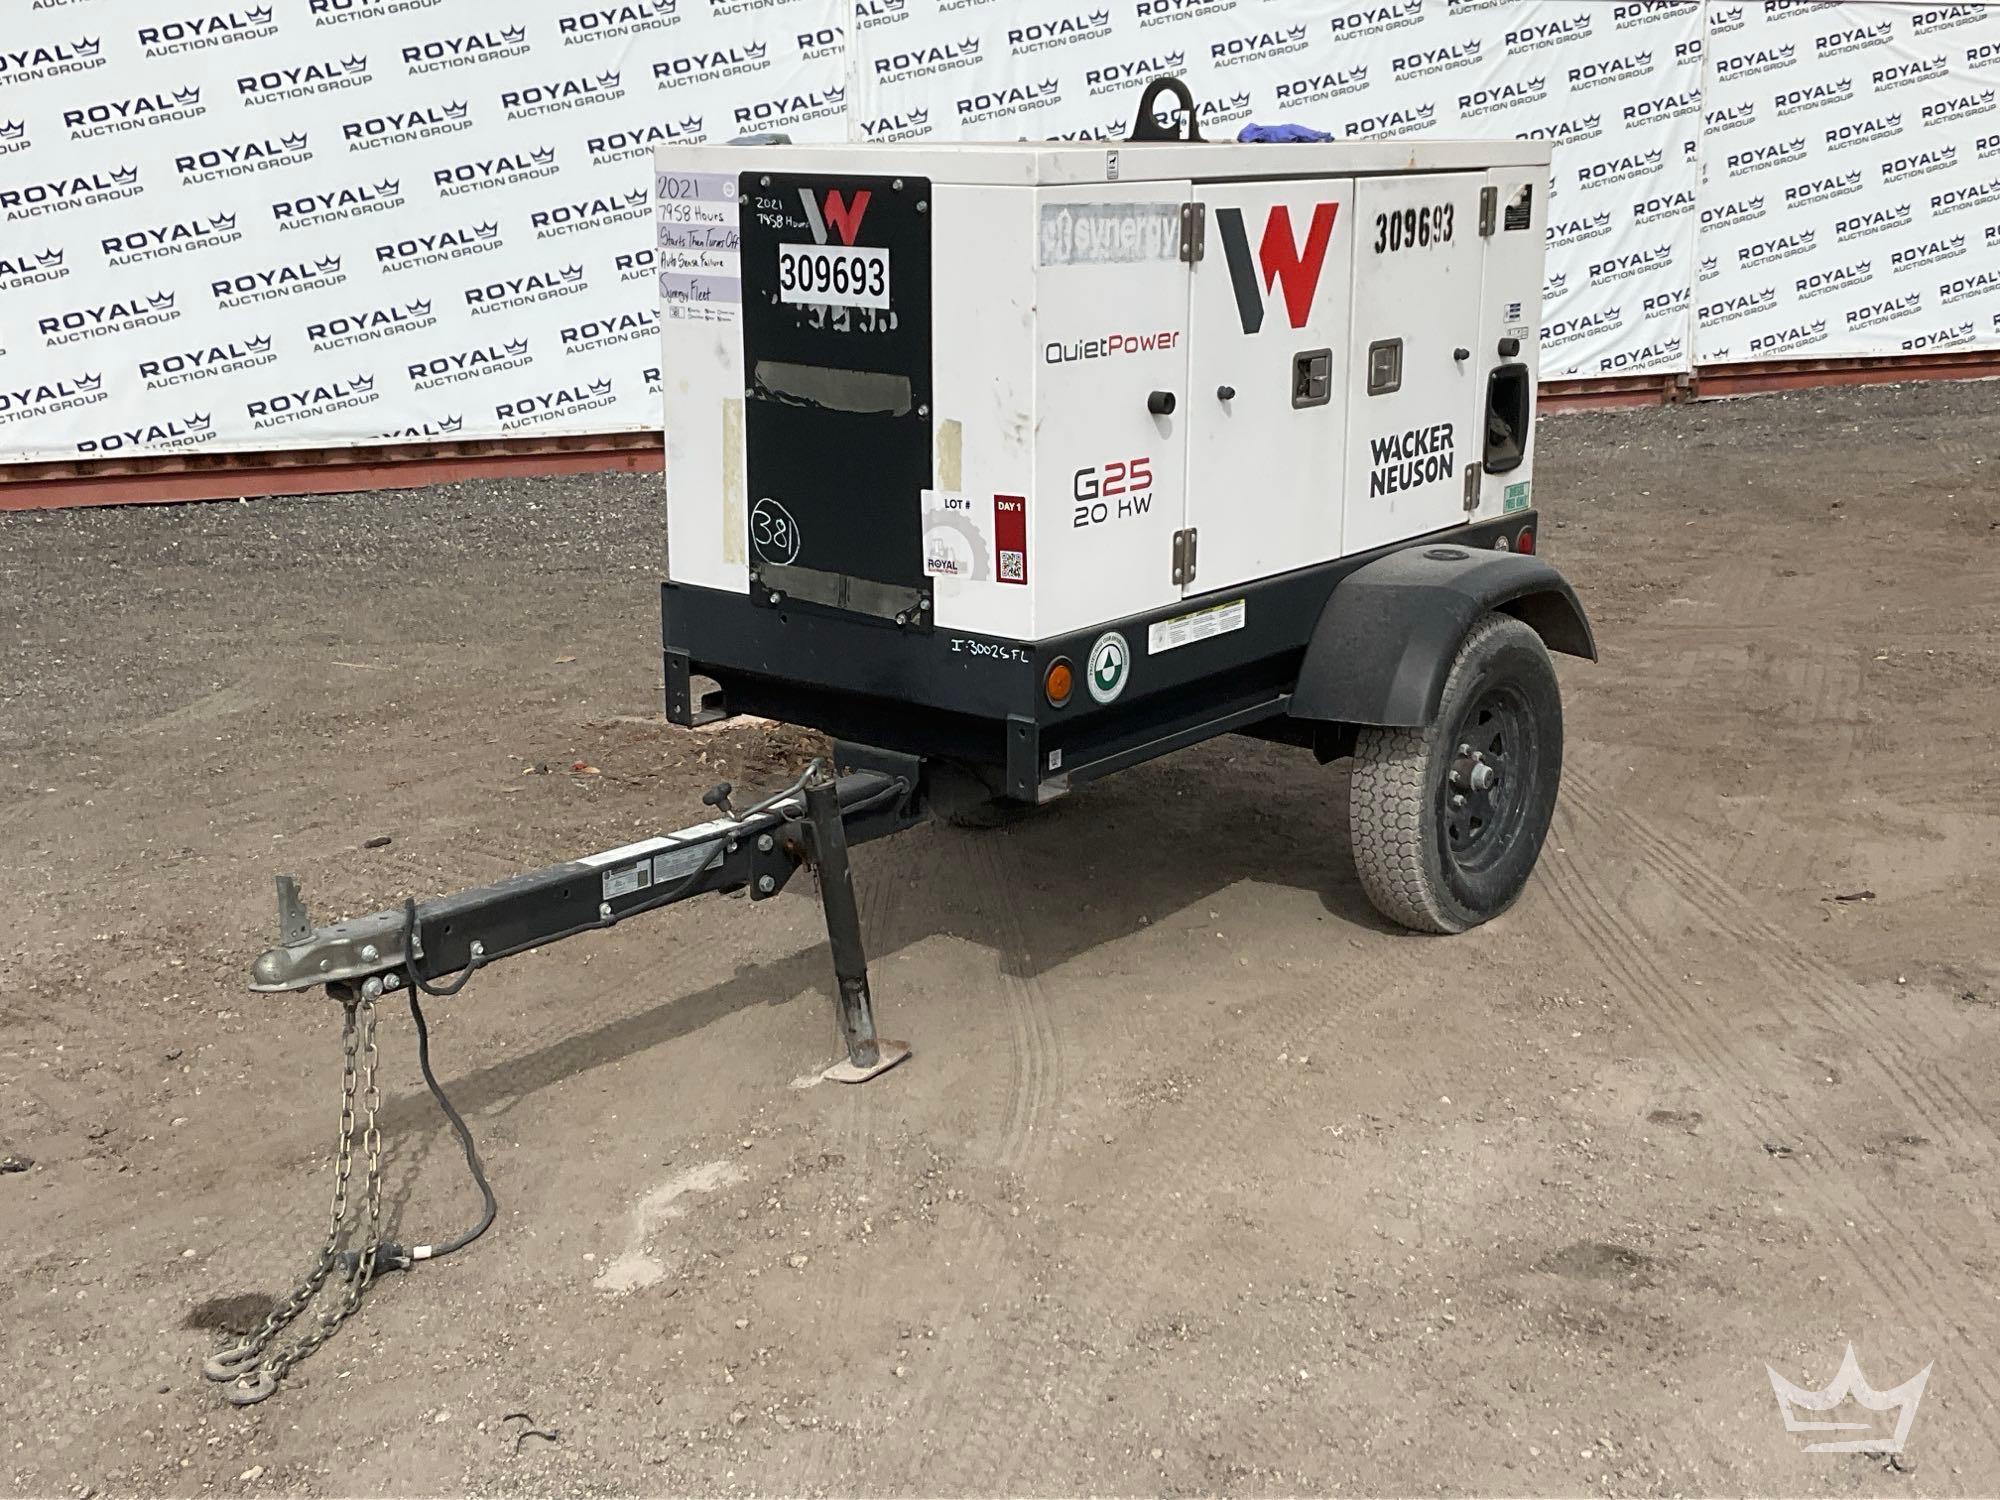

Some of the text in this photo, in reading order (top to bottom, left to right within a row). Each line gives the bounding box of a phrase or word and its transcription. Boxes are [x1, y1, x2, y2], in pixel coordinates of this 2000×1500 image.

[138, 12, 247, 45] ROYAL
[558, 3, 654, 34] ROYAL
[564, 16, 681, 46] AUCTION GROUP
[1007, 16, 1089, 45] ROYAL
[1331, 5, 1404, 32] ROYAL
[1333, 16, 1424, 43] AUCTION GROUP
[1504, 19, 1573, 46] ROYAL
[145, 26, 279, 58] AUCTION GROUP
[401, 32, 502, 63] ROYAL
[1011, 27, 1112, 56] AUCTION GROUP
[1210, 30, 1287, 58] ROYAL
[1214, 41, 1309, 69] AUCTION GROUP
[1506, 29, 1592, 56] AUCTION GROUP
[408, 45, 530, 76] AUCTION GROUP
[652, 48, 744, 78] ROYAL
[874, 44, 959, 74] ROYAL
[878, 55, 983, 85] AUCTION GROUP
[1716, 49, 1779, 73] ROYAL
[1718, 58, 1796, 83] AUCTION GROUP
[237, 62, 342, 94] ROYAL
[657, 60, 771, 90] AUCTION GROUP
[1276, 71, 1349, 99] ROYAL
[244, 74, 373, 107] AUCTION GROUP
[501, 77, 597, 109] ROYAL
[507, 90, 625, 121] AUCTION GROUP
[956, 85, 1038, 115] ROYAL
[1278, 82, 1369, 110] AUCTION GROUP
[1458, 82, 1528, 109] ROYAL
[63, 94, 174, 128] ROYAL
[960, 96, 1062, 126] AUCTION GROUP
[1460, 92, 1547, 120] AUCTION GROUP
[1921, 94, 1980, 118] ROYAL
[1923, 103, 1996, 128] AUCTION GROUP
[70, 106, 206, 141] AUCTION GROUP
[342, 108, 444, 140] ROYAL
[349, 120, 473, 152] AUCTION GROUP
[1825, 118, 1886, 143] ROYAL
[1827, 127, 1903, 152] AUCTION GROUP
[175, 139, 282, 173] ROYAL
[182, 152, 313, 186] AUCTION GROUP
[433, 154, 531, 186] ROYAL
[1578, 154, 1645, 181] ROYAL
[1727, 142, 1789, 168] ROYAL
[1729, 152, 1806, 178] AUCTION GROUP
[439, 165, 560, 198] AUCTION GROUP
[658, 176, 699, 199] 2021
[1580, 164, 1663, 191] AUCTION GROUP
[1784, 175, 1846, 201] ROYAL
[272, 186, 375, 219] ROYAL
[530, 196, 625, 228] ROYAL
[659, 203, 724, 221] 7958 Hours
[755, 196, 783, 210] 2021
[1786, 184, 1862, 210] AUCTION GROUP
[279, 198, 405, 232] AUCTION GROUP
[536, 207, 652, 240] AUCTION GROUP
[756, 213, 784, 228] 7958
[1374, 202, 1454, 254] 309693
[101, 220, 210, 255] ROYAL
[108, 232, 242, 268] AUCTION GROUP
[375, 229, 475, 262] ROYAL
[660, 226, 685, 247] Starts
[687, 230, 704, 247] Then
[382, 240, 503, 274] AUCTION GROUP
[1588, 250, 1654, 278] ROYAL
[211, 263, 316, 298] ROYAL
[780, 253, 885, 297] 309693
[1590, 259, 1672, 287] AUCTION GROUP
[1795, 266, 1856, 292] ROYAL
[1797, 274, 1872, 301] AUCTION GROUP
[218, 274, 347, 310] AUCTION GROUP
[464, 272, 560, 305] ROYAL
[470, 282, 588, 317] AUCTION GROUP
[691, 279, 711, 301] Fleet
[38, 299, 149, 335] ROYAL
[1697, 293, 1760, 320] ROYAL
[1699, 301, 1777, 329] AUCTION GROUP
[1845, 298, 1905, 324] ROYAL
[1848, 306, 1922, 332] AUCTION GROUP
[45, 310, 181, 347] AUCTION GROUP
[138, 343, 246, 378] ROYAL
[1045, 331, 1180, 364] QuietPower
[146, 354, 277, 391] AUCTION GROUP
[407, 346, 505, 380] ROYAL
[414, 356, 533, 392] AUCTION GROUP
[247, 383, 350, 418] ROYAL
[254, 393, 380, 430] AUCTION GROUP
[495, 386, 590, 420] ROYAL
[501, 396, 617, 431] AUCTION GROUP
[1370, 423, 1454, 466] WACKER
[1074, 457, 1152, 502] G25
[1370, 452, 1454, 499] NEUSON
[944, 499, 963, 509] LOT
[998, 501, 1021, 512] DAY 1
[1073, 503, 1108, 528] 20
[928, 559, 958, 570] ROYAL
